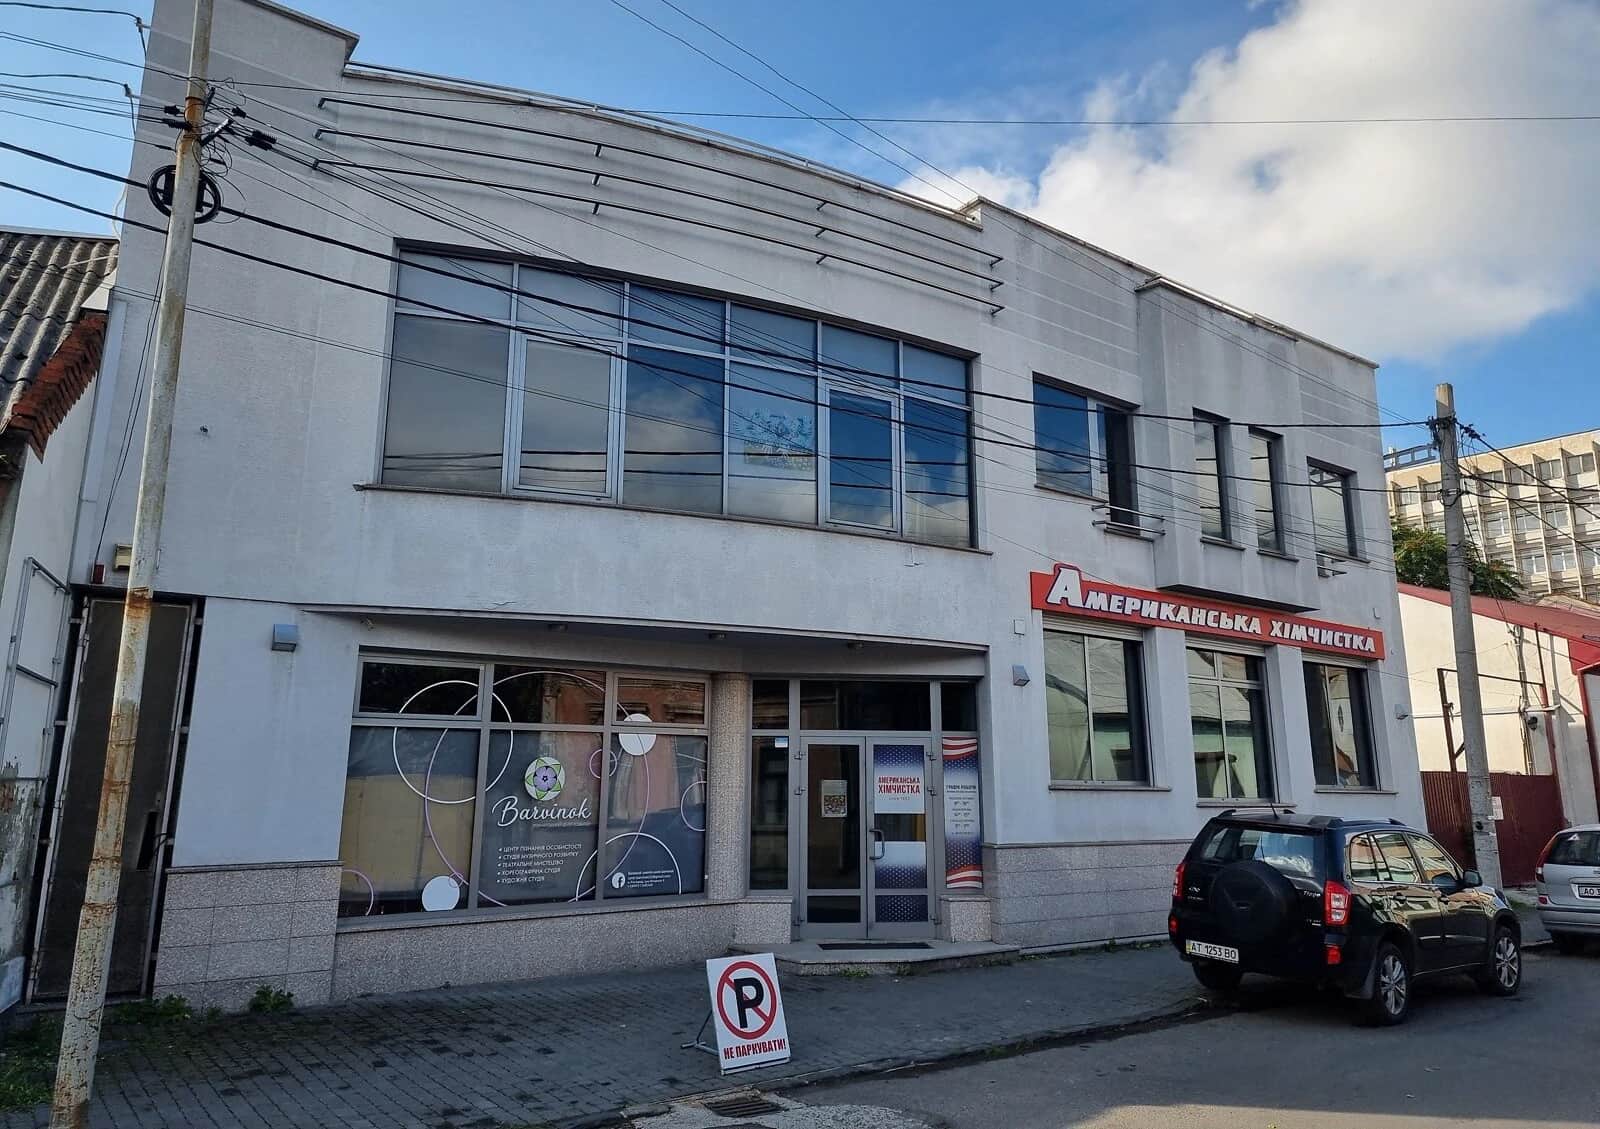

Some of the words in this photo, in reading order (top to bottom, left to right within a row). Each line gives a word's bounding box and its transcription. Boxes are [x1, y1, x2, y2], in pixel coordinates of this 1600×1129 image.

[1269, 620, 1376, 653] ХІМЧИСТКА
[878, 776, 920, 784] АМЕРИКАНСЬКА
[878, 784, 920, 794] ХІМЧИСТКА
[492, 796, 592, 827] Barvinok
[1191, 943, 1202, 952] AT
[1204, 945, 1222, 956] 1253
[1224, 948, 1237, 959] BO
[723, 1046, 735, 1060] НЕ
[735, 1039, 787, 1057] ПАРКУВАТИ!
